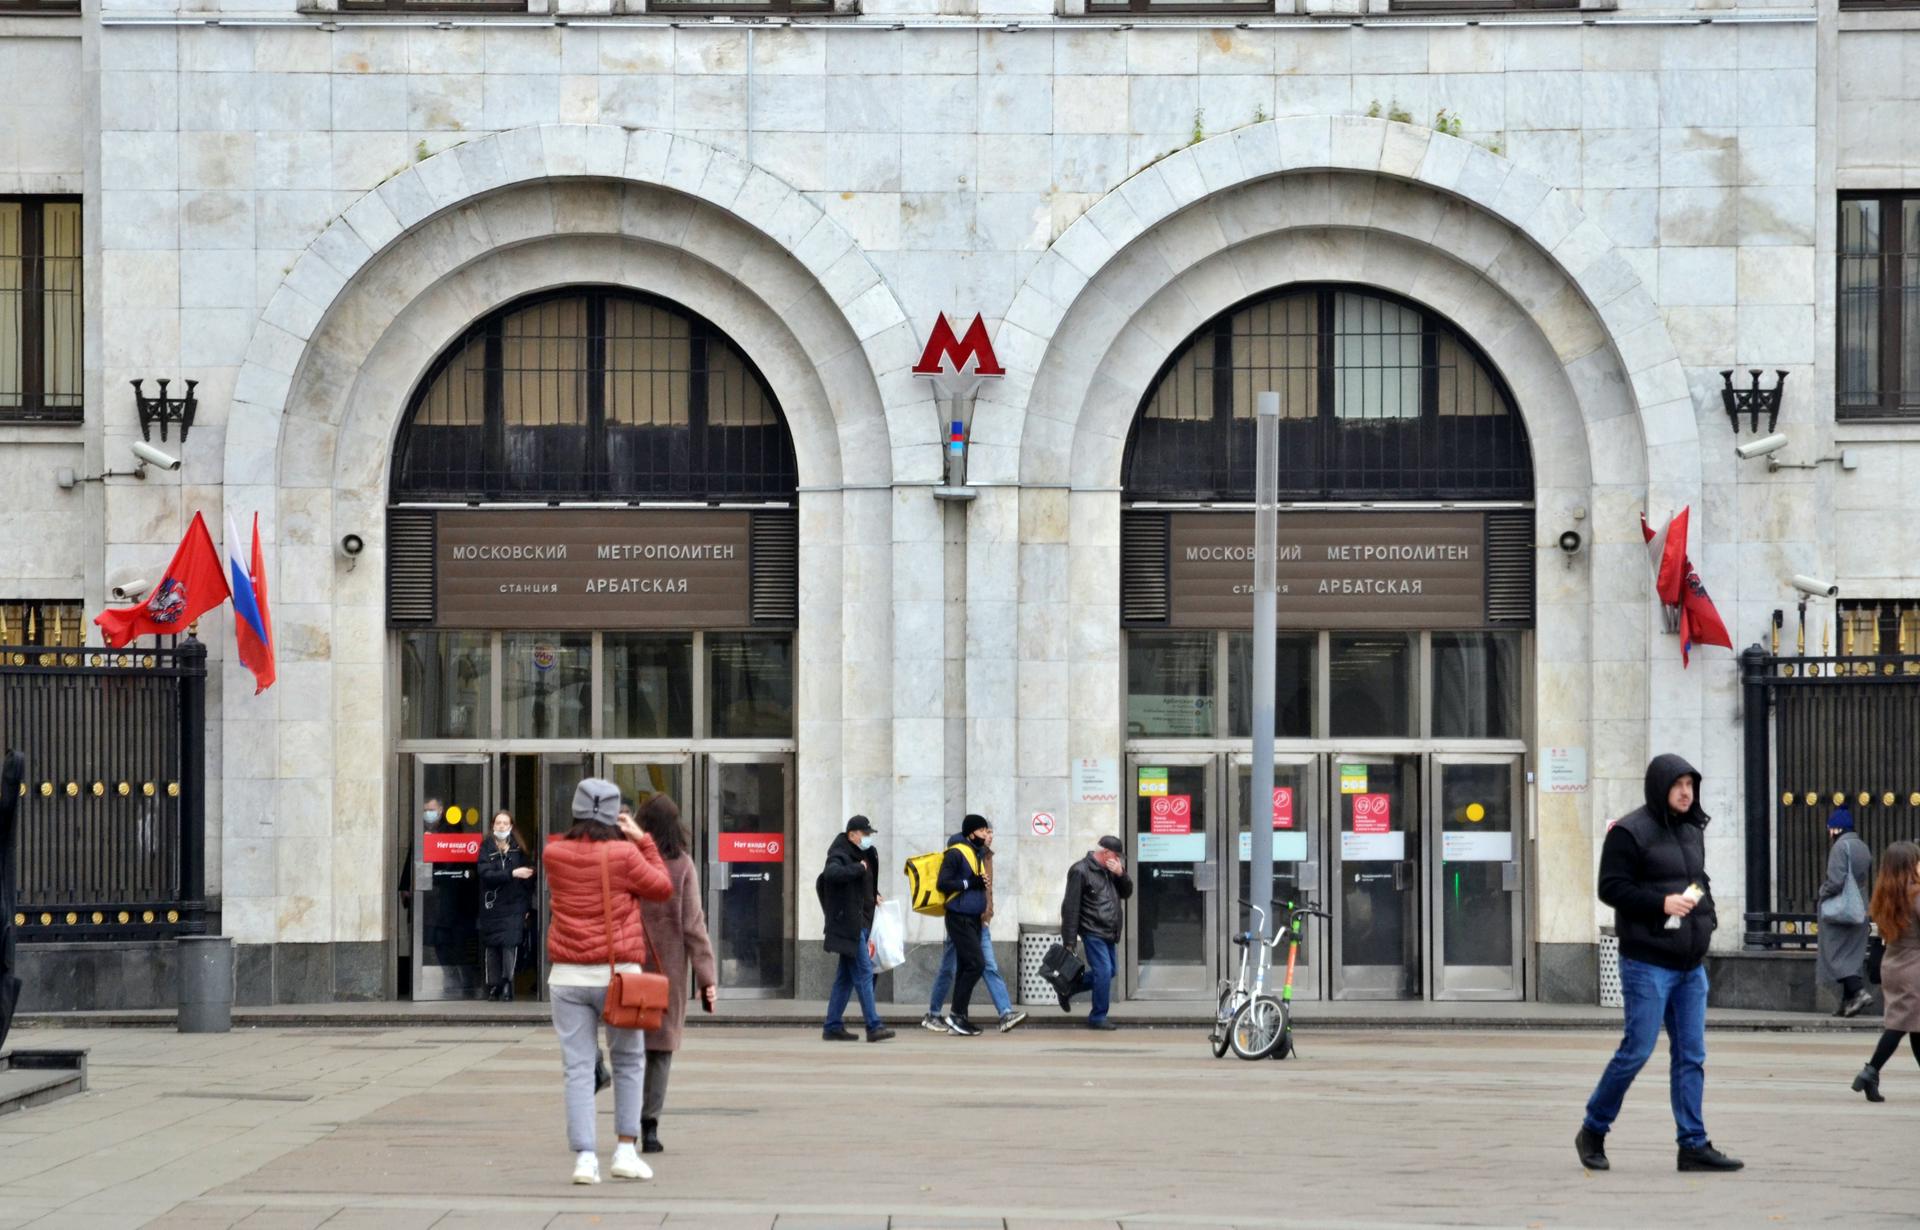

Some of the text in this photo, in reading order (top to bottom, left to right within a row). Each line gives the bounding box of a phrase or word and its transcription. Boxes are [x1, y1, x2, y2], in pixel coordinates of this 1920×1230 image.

[453, 543, 734, 560] МОСКОВСКИЙ МЕТРОПОЛИТЕН
[1186, 544, 1469, 561] МОСКОВИЙ МЕТРОПОЛИТЕН
[499, 577, 688, 593] СТАНЦИЯ АРБАТСКАЯ
[1232, 578, 1422, 594] СТАИЯ АРБАТСКАЯ
[436, 841, 449, 849] Нет
[733, 841, 747, 849] Нет
